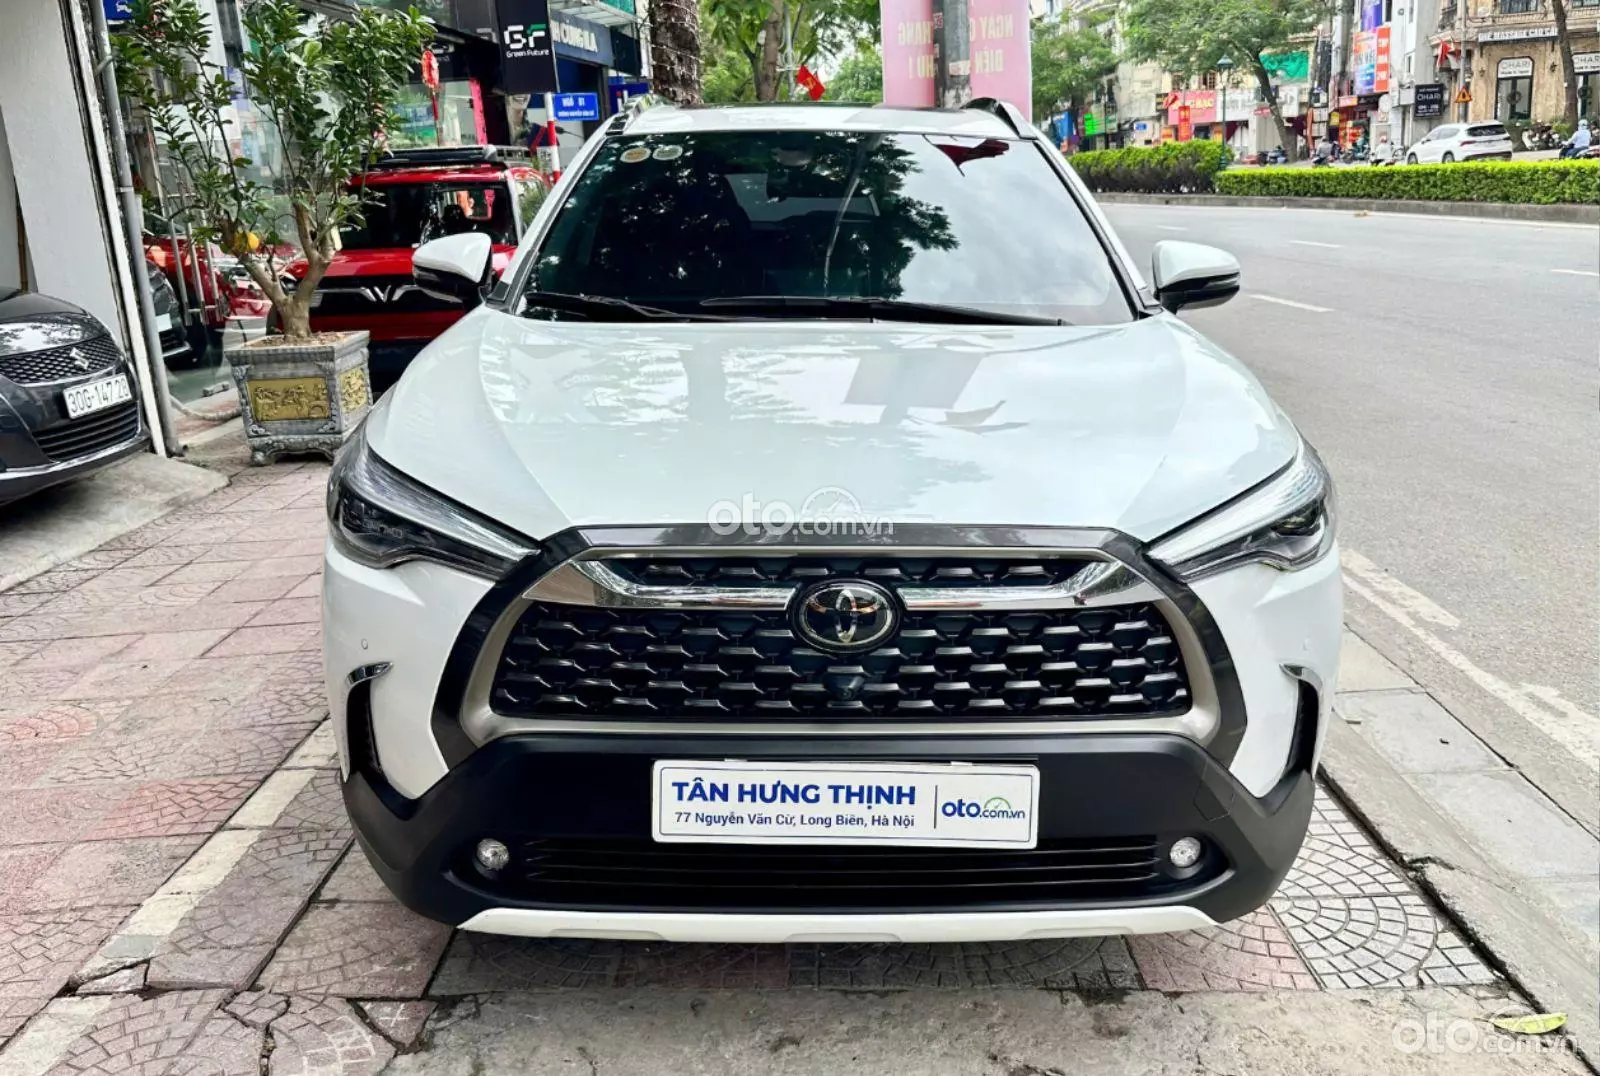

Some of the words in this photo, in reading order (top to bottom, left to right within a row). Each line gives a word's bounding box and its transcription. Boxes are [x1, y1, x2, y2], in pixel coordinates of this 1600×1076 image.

[506, 50, 526, 58] Green
[527, 48, 550, 57] Future
[1574, 55, 1600, 64] OHAR
[1500, 60, 1531, 70] OHARI
[671, 777, 729, 803] TÂN
[737, 780, 821, 804] HƯNG
[827, 784, 916, 810] THỊNH
[941, 798, 1026, 819] oto.com.vn
[675, 812, 691, 823] 77
[695, 811, 744, 827] Nguyễn
[747, 813, 772, 825] Văn
[775, 812, 796, 827] Cừ,
[800, 814, 832, 828] Long
[835, 814, 868, 828] Biên,
[871, 815, 889, 827] Hà
[892, 814, 915, 829] Nội
